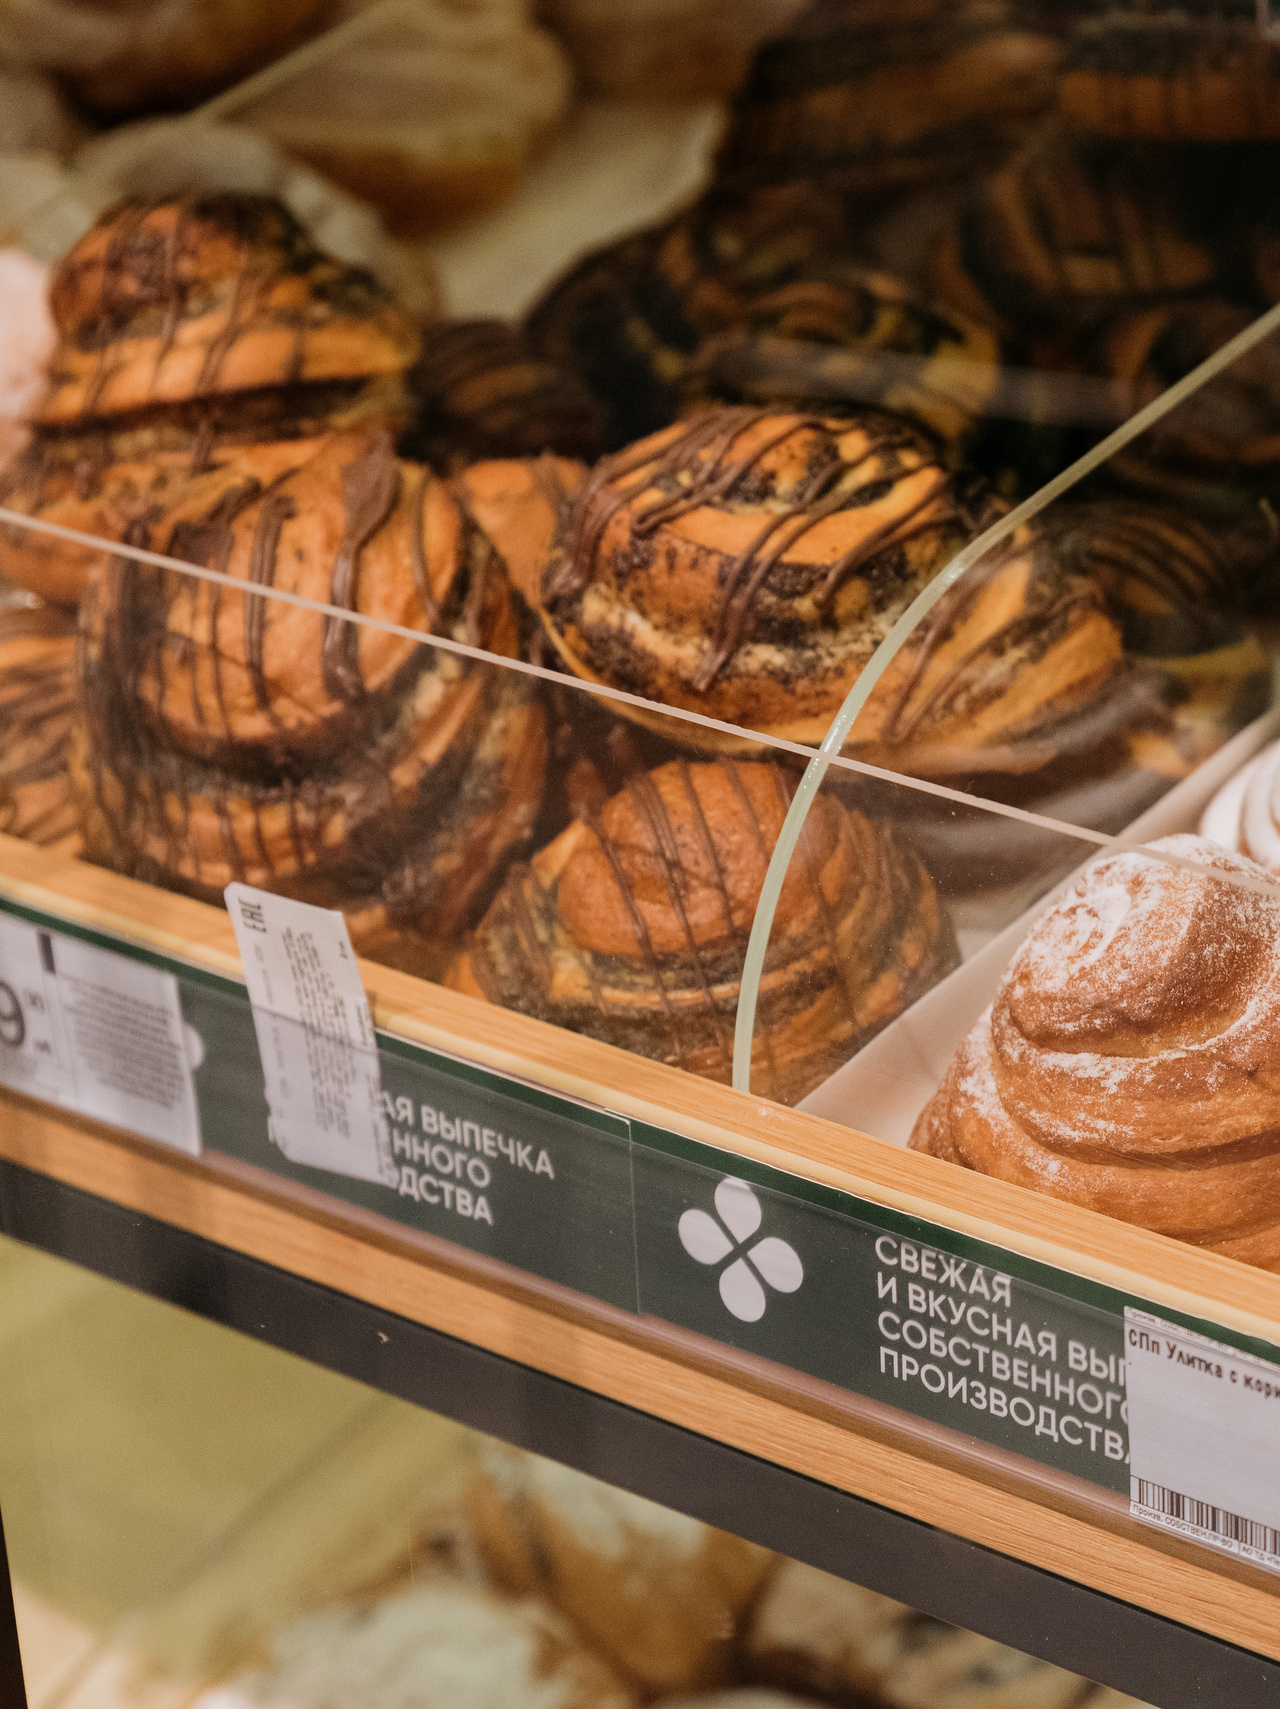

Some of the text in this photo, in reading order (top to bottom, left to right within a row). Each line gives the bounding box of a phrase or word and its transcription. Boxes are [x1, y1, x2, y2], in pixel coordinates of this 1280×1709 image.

[391, 1127, 491, 1188] ННОГО
[420, 1104, 555, 1180] ВЫПЕЧКА
[399, 1164, 494, 1227] ДСТВА
[874, 1235, 1012, 1308] СВЕЖАЯ
[877, 1271, 897, 1304] И
[907, 1282, 1057, 1362] ВКУСНАЯ
[1165, 1340, 1223, 1379] Улитка
[1229, 1368, 1238, 1384] с
[879, 1345, 1130, 1464] ПРОИЗВОДСТВ
[1132, 1503, 1164, 1523] Произв.
